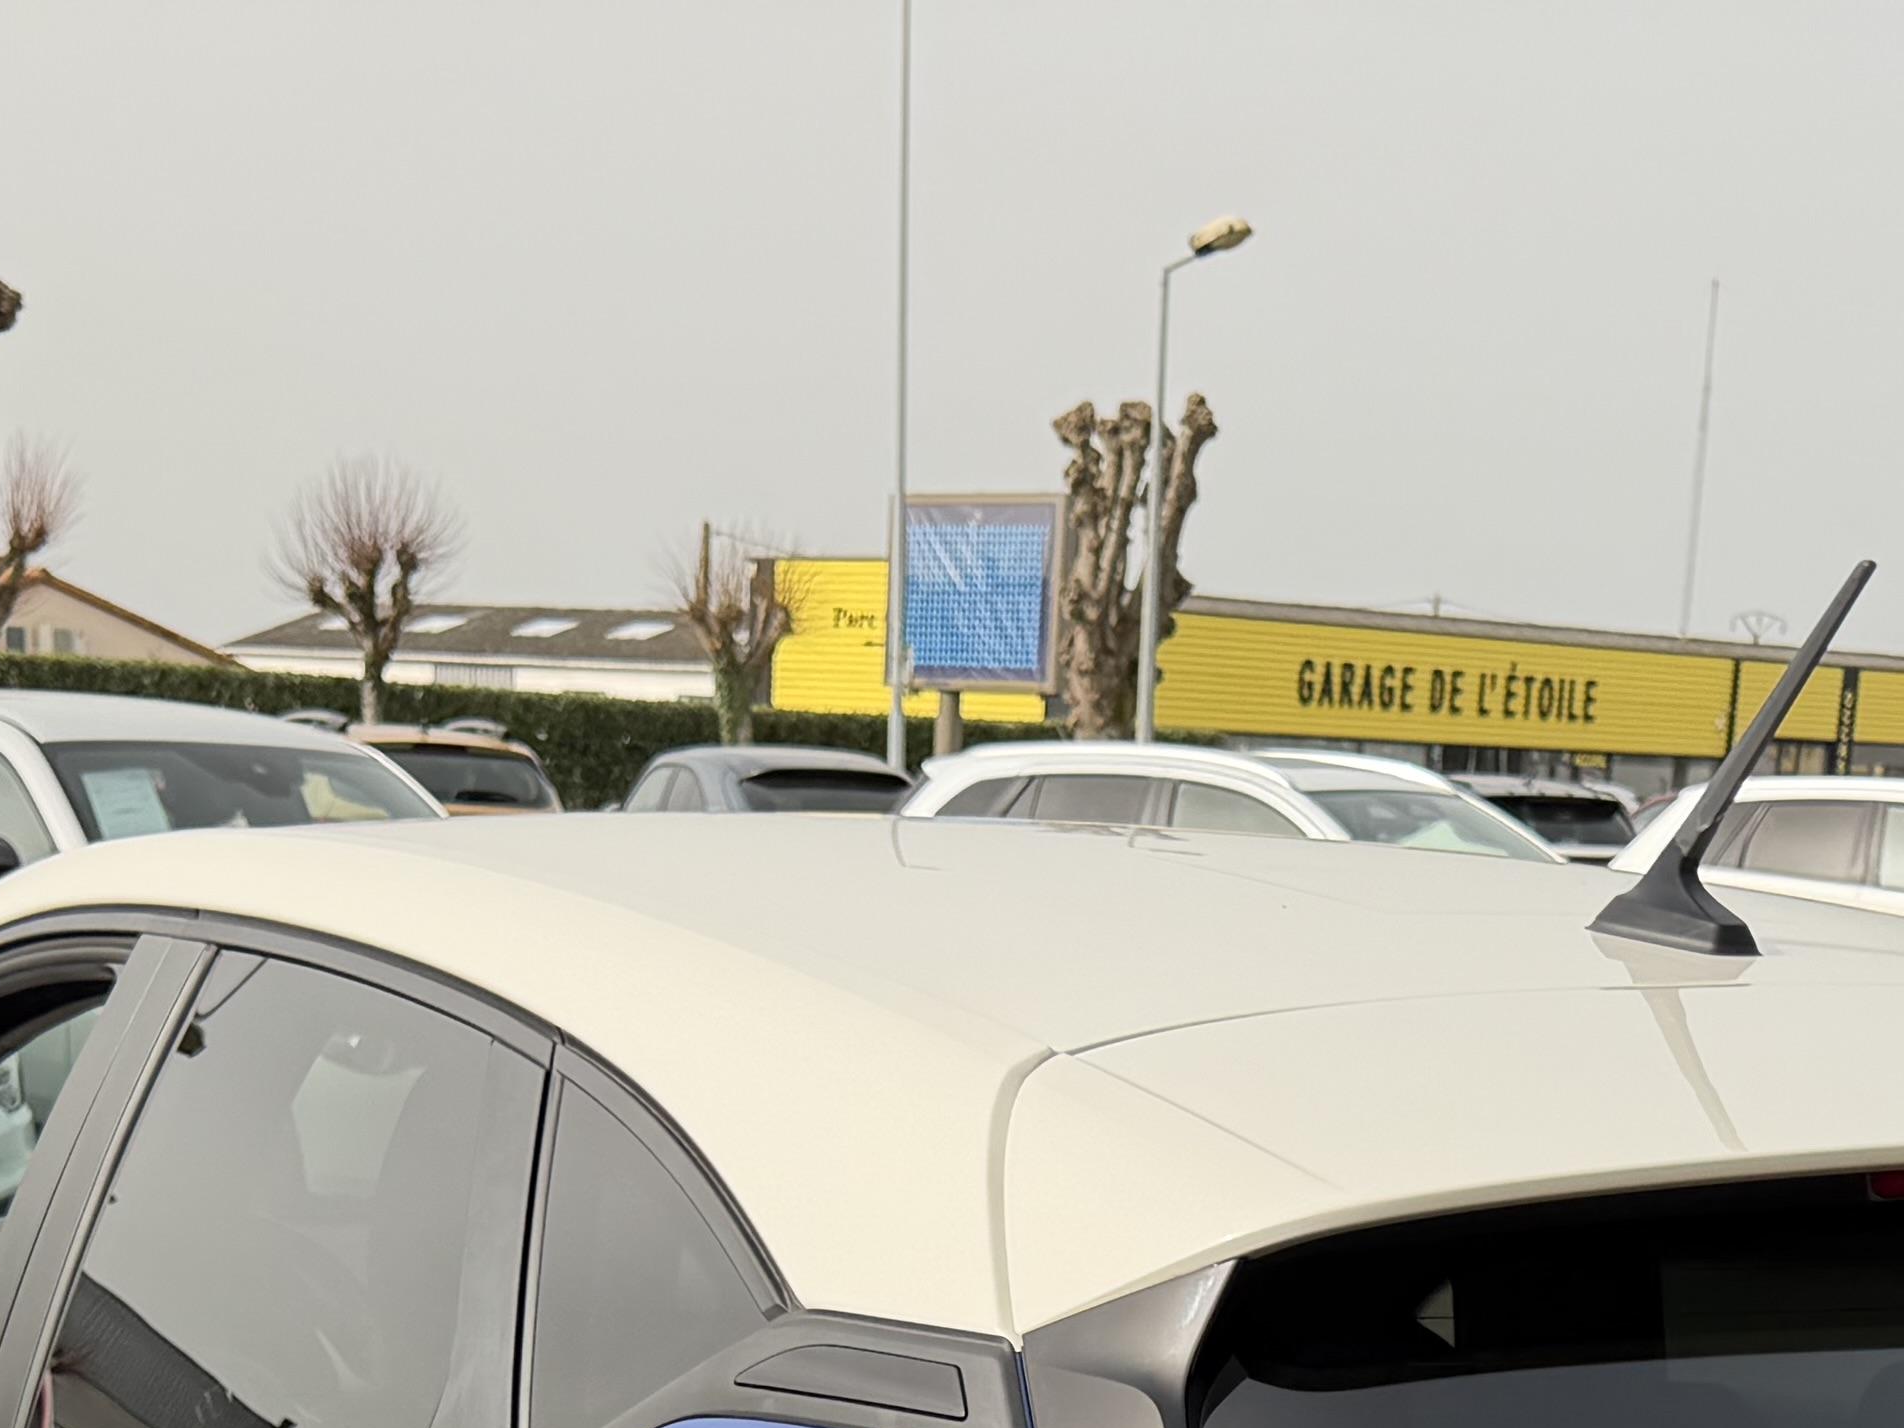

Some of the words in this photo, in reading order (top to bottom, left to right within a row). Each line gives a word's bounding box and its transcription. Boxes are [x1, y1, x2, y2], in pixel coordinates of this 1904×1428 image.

[1298, 659, 1415, 712] GARAGE
[1429, 669, 1464, 716] DE
[1478, 662, 1597, 723] L'ÉTOILE
